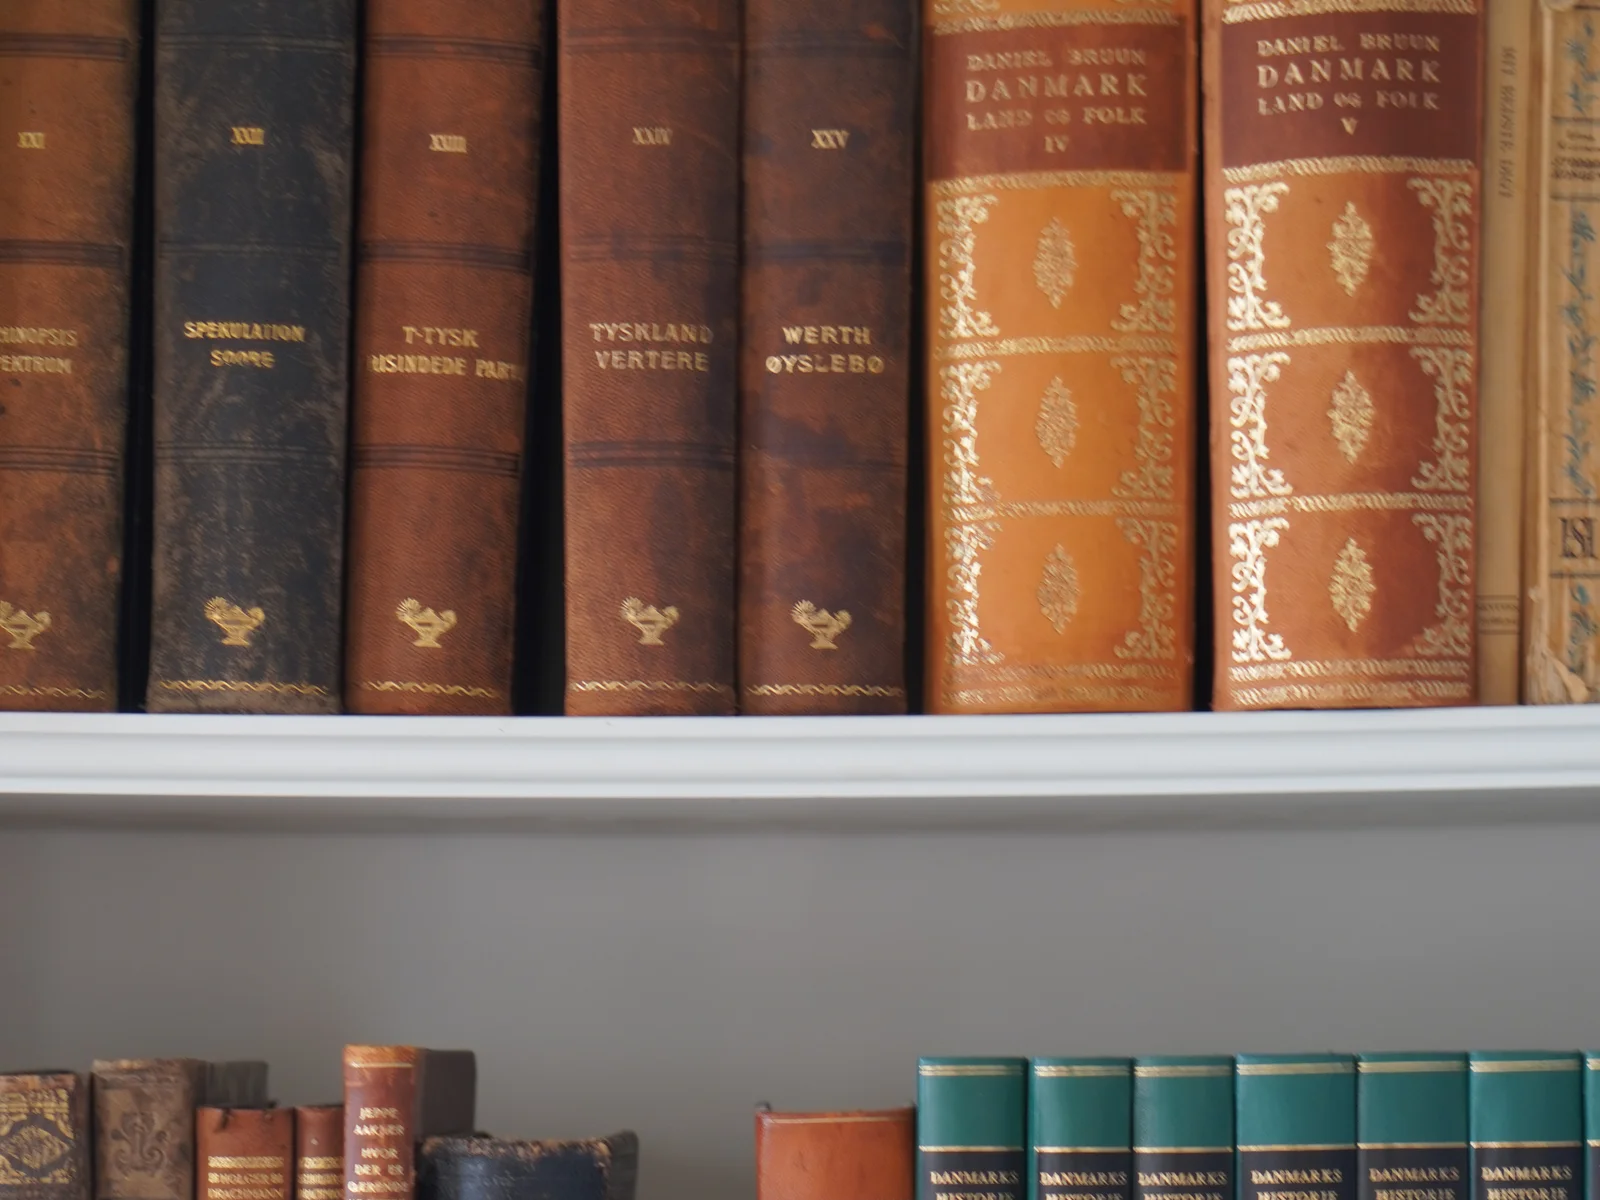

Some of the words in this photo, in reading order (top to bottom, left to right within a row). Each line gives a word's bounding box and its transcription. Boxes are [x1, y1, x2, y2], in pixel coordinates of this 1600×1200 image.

[1257, 35, 1345, 56] DANIEL
[1360, 34, 1440, 52] BRUUN
[1257, 58, 1441, 88] DANMARK
[965, 73, 1147, 103] DANMARK
[1257, 92, 1324, 116] LAND
[1334, 92, 1362, 108] OG
[1376, 90, 1440, 111] FOLK
[967, 108, 1033, 131] LAND
[1082, 107, 1147, 125] FOLK
[1340, 117, 1358, 135] V
[811, 129, 849, 149] XXV
[1044, 135, 1069, 153] IV
[184, 321, 305, 342] SPEKULATION
[589, 322, 714, 344] TYSKLAND
[782, 325, 872, 345] WERTH
[595, 350, 708, 371] VERTERE
[930, 1170, 1019, 1185] DANMARKS
[1039, 1171, 1127, 1186] DANMARKS
[1137, 1171, 1228, 1186] DANMARKS
[1250, 1169, 1343, 1184] DANMARKS
[1369, 1166, 1460, 1182] DANMARKS
[1481, 1165, 1573, 1181] DANMARKS
